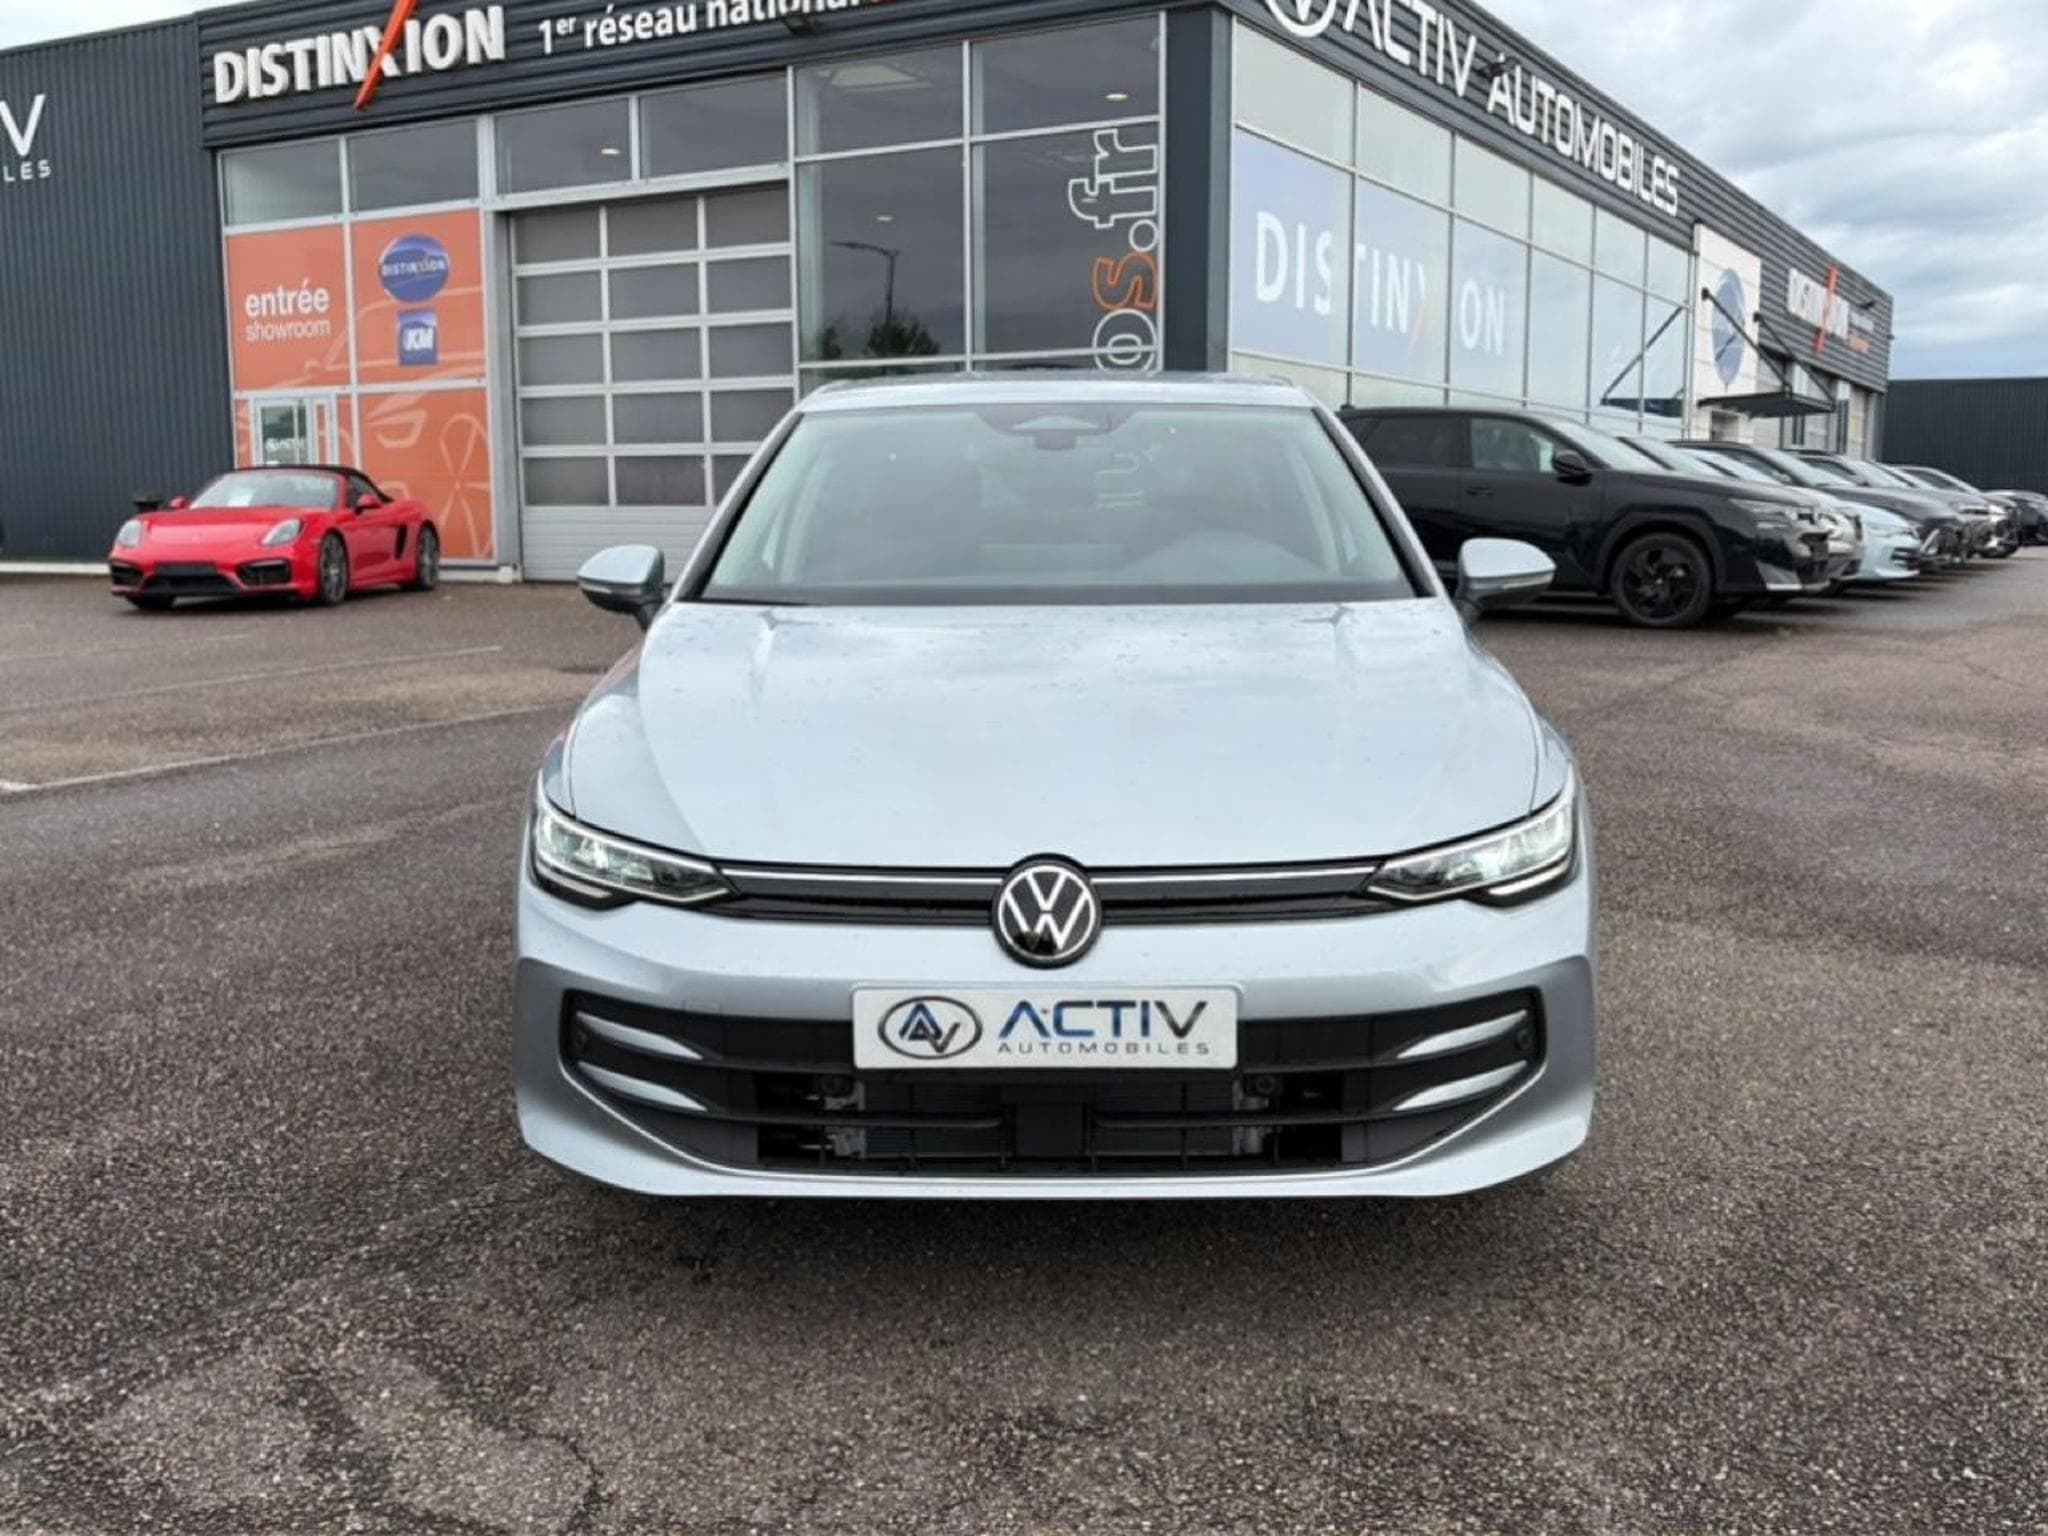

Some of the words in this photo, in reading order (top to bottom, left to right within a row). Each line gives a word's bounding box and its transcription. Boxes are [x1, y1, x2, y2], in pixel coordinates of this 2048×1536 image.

[584, 4, 698, 48] réseau
[706, 0, 859, 28] natio
[213, 0, 505, 111] DISTINXION
[1487, 54, 1680, 217] AUTOMOBILES
[245, 278, 331, 317] entrée
[1256, 210, 1505, 356] DISTINON
[246, 319, 332, 342] showroom
[999, 1000, 1208, 1039] ACTIV
[999, 1041, 1209, 1055] AUTOMOBILES
